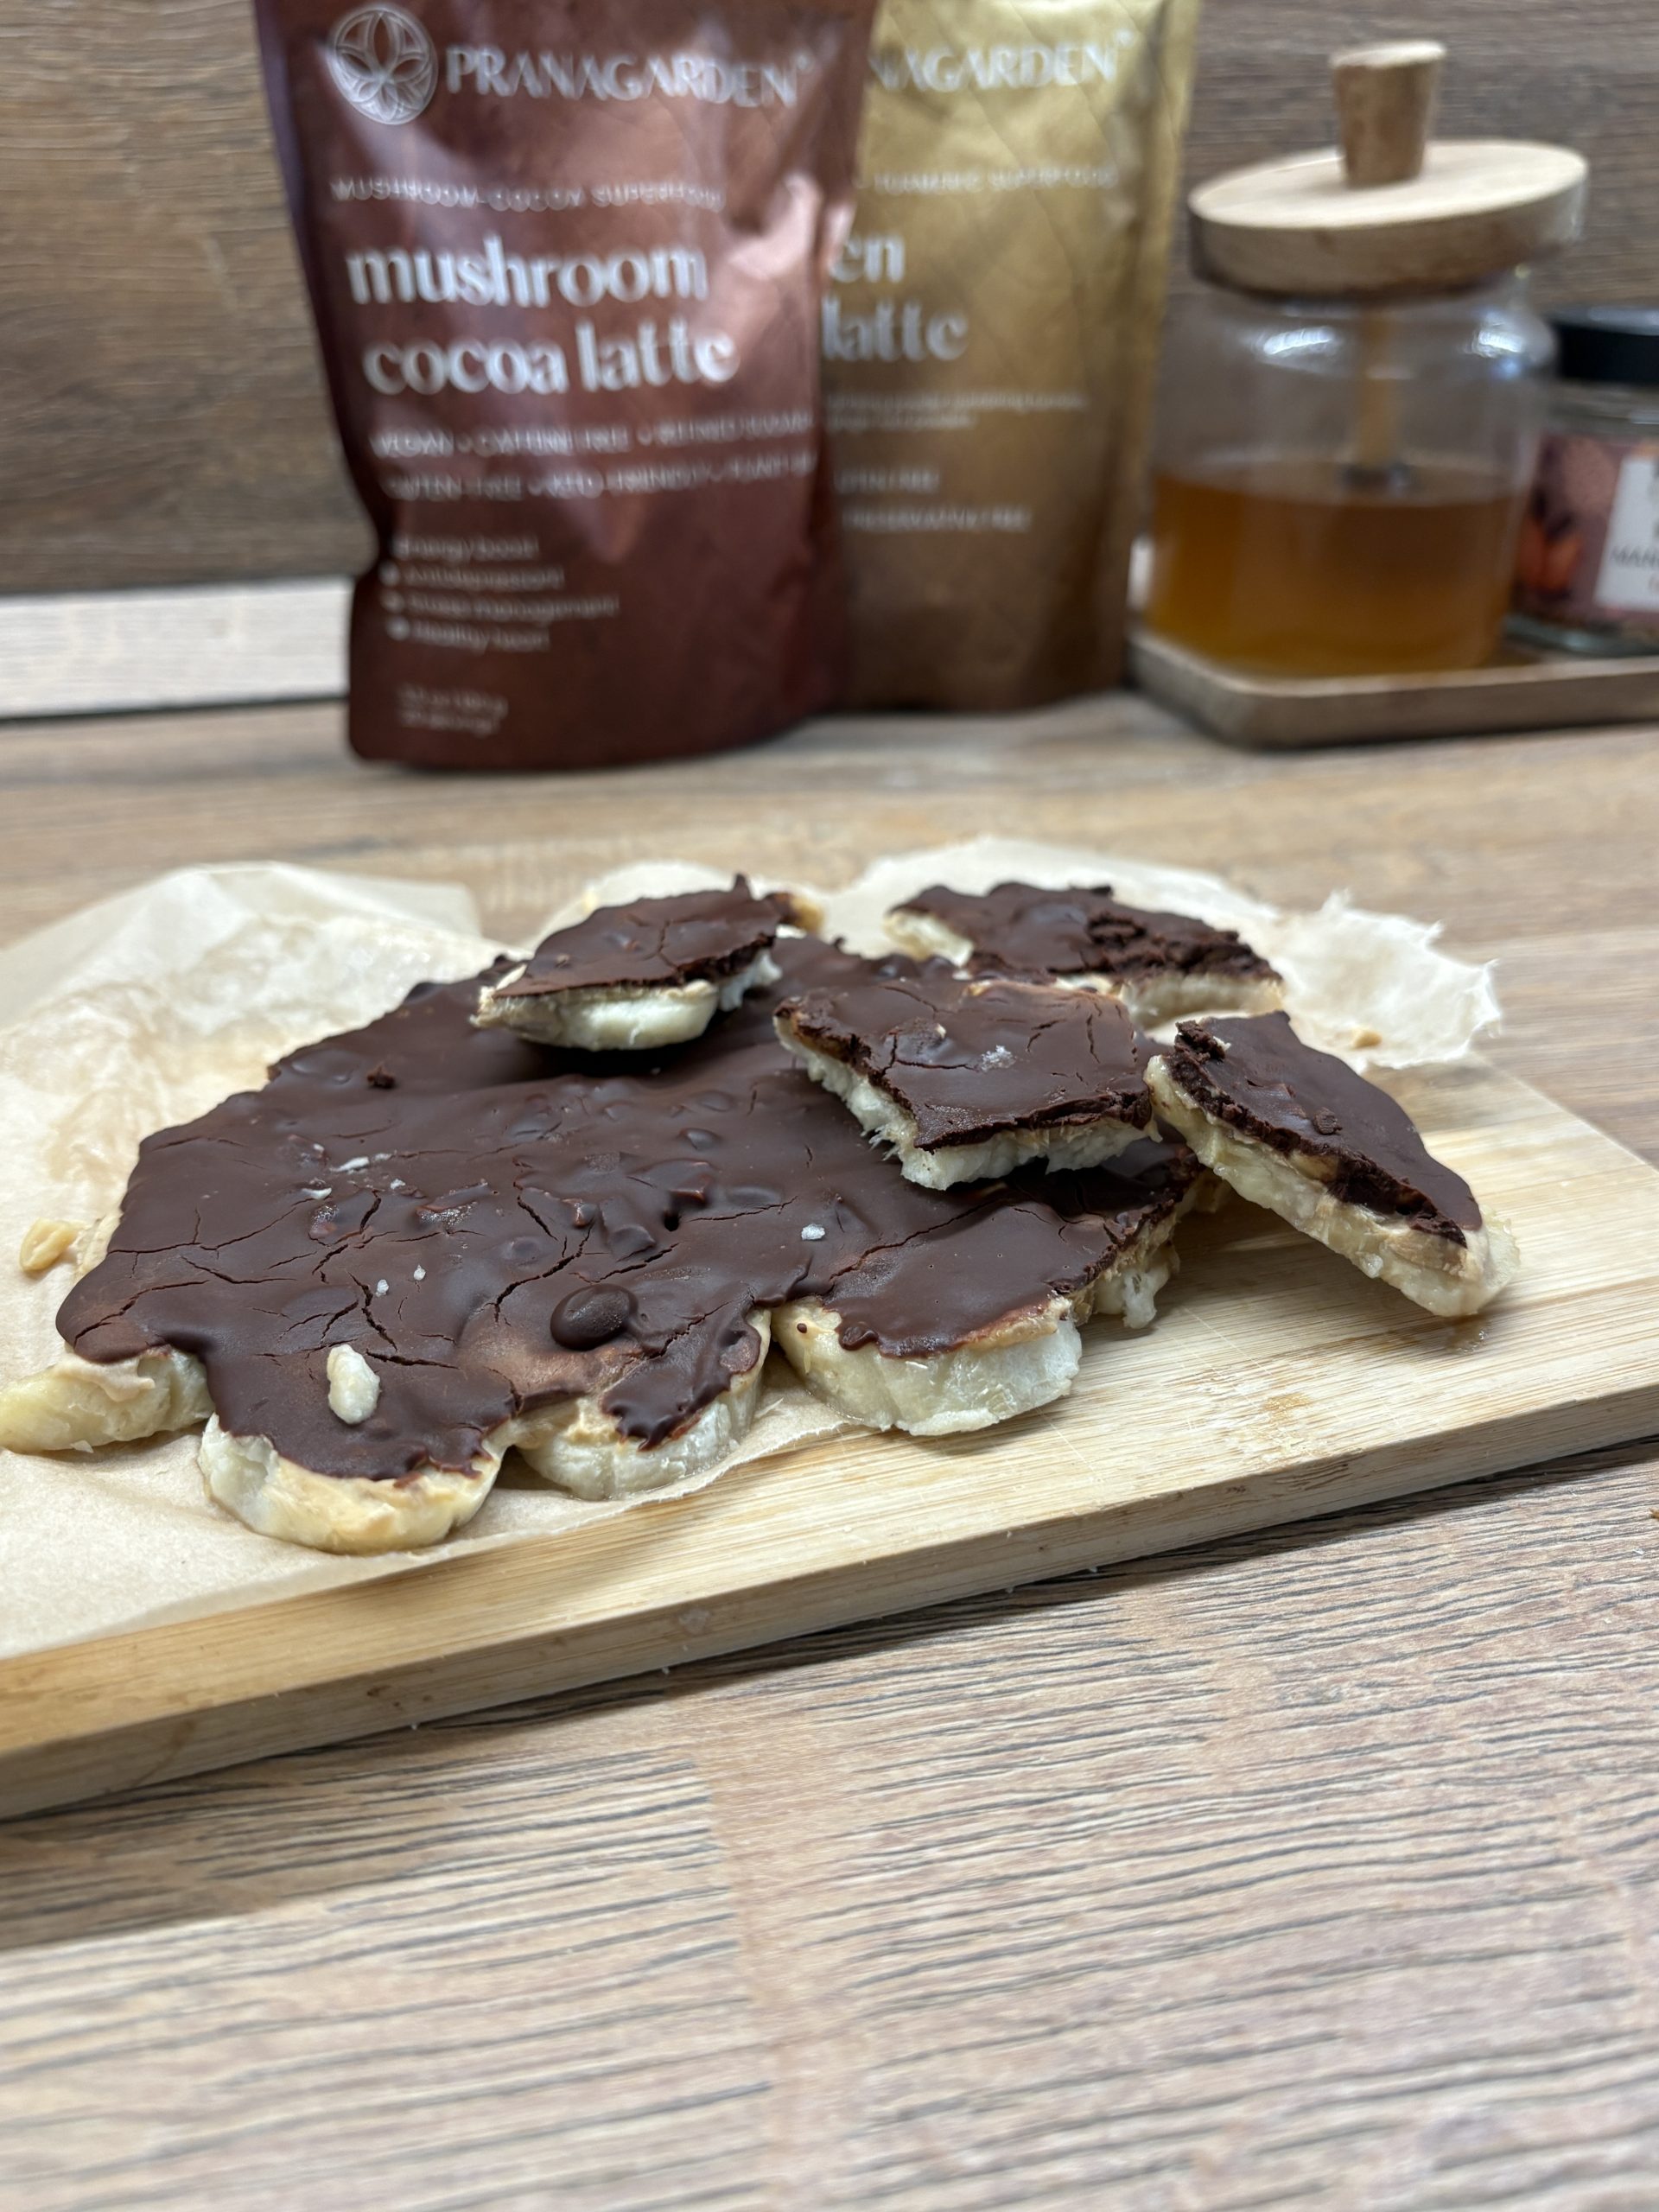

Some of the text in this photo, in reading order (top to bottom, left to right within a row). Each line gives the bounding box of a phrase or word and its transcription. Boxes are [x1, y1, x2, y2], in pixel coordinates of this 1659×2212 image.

[348, 233, 708, 306] mushroom
[363, 318, 741, 394] cocoa latte
[820, 296, 969, 360] latte
